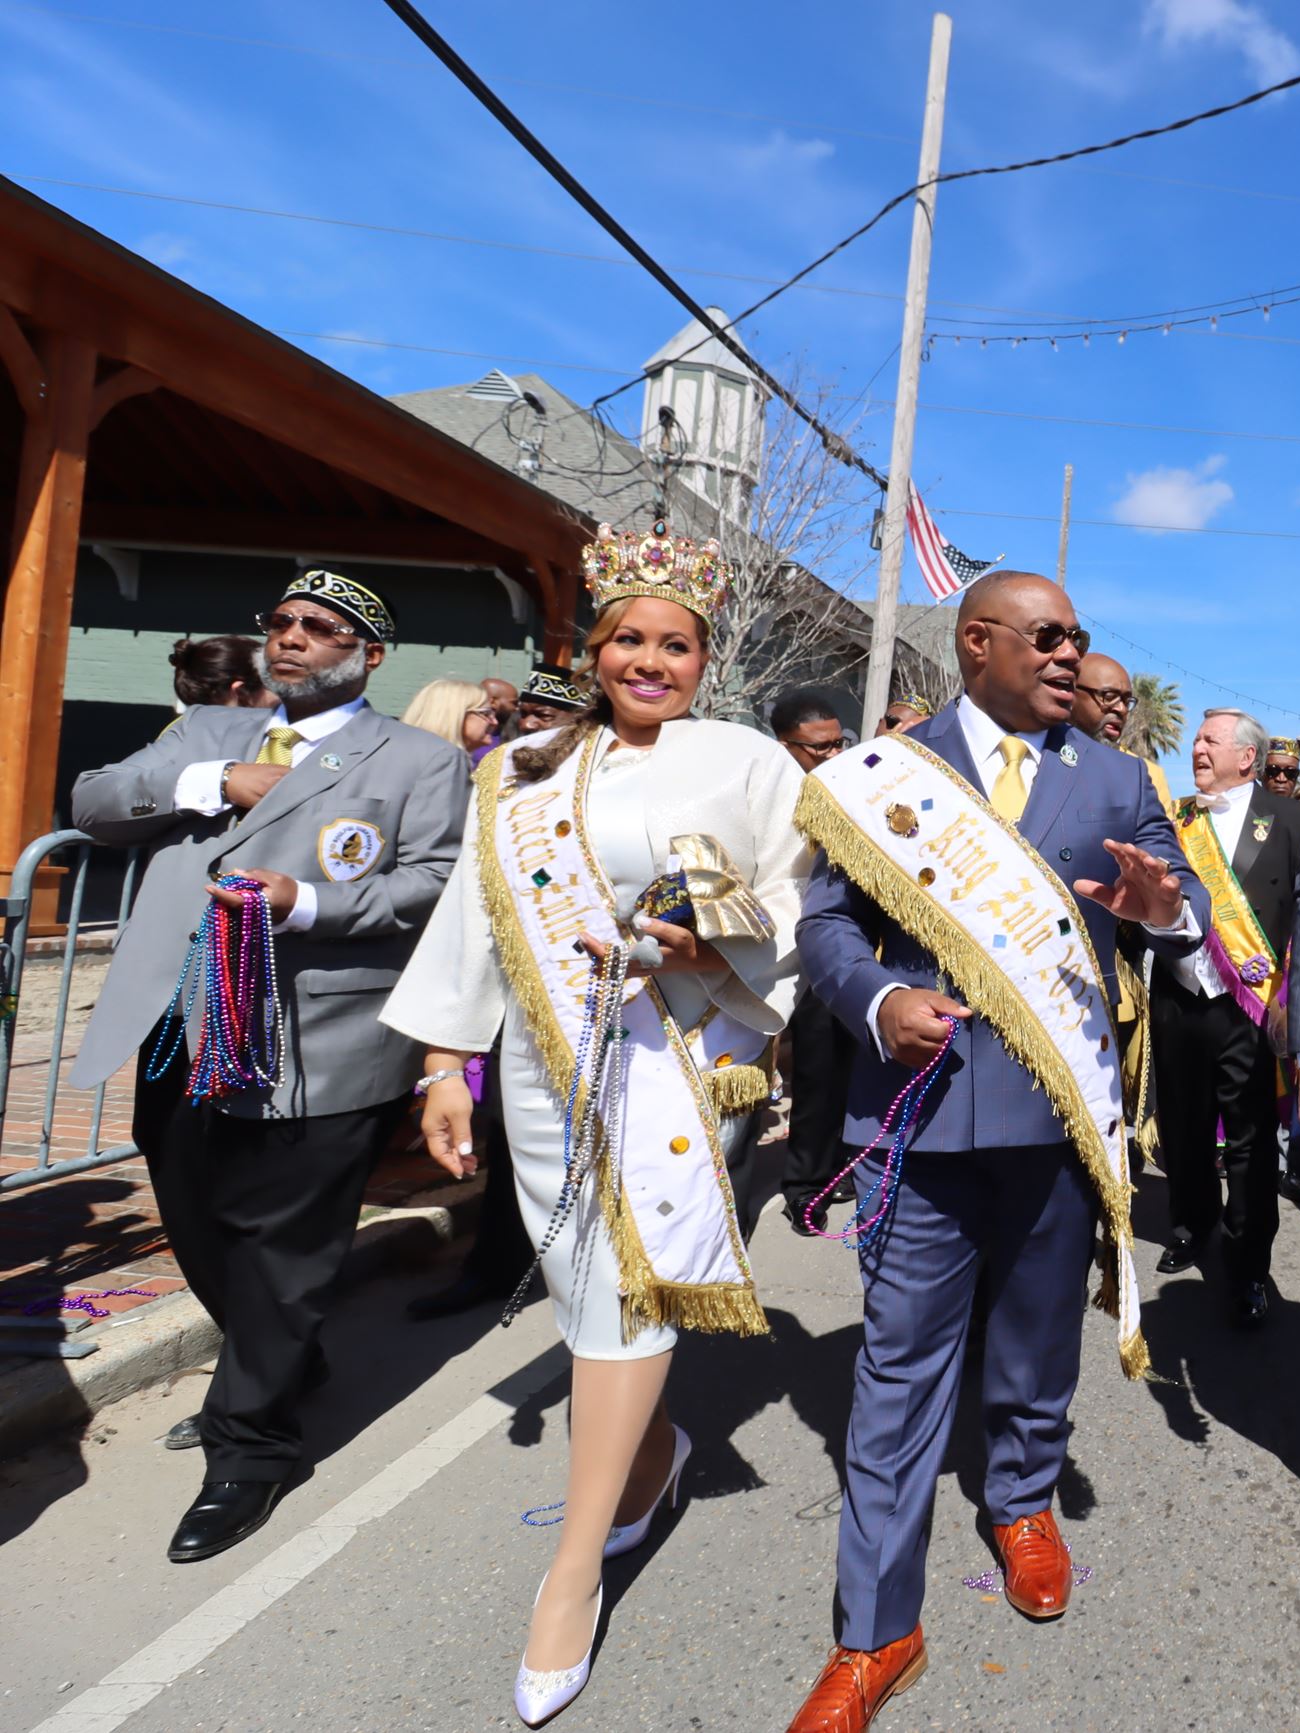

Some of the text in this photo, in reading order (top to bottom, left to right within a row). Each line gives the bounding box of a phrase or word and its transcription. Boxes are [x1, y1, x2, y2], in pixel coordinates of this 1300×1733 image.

[506, 791, 561, 874] Queen
[1188, 834, 1212, 862] KING
[1200, 863, 1226, 899] ARGUS
[519, 873, 595, 944] Zulu
[918, 811, 1093, 1031] King Zulu 2023
